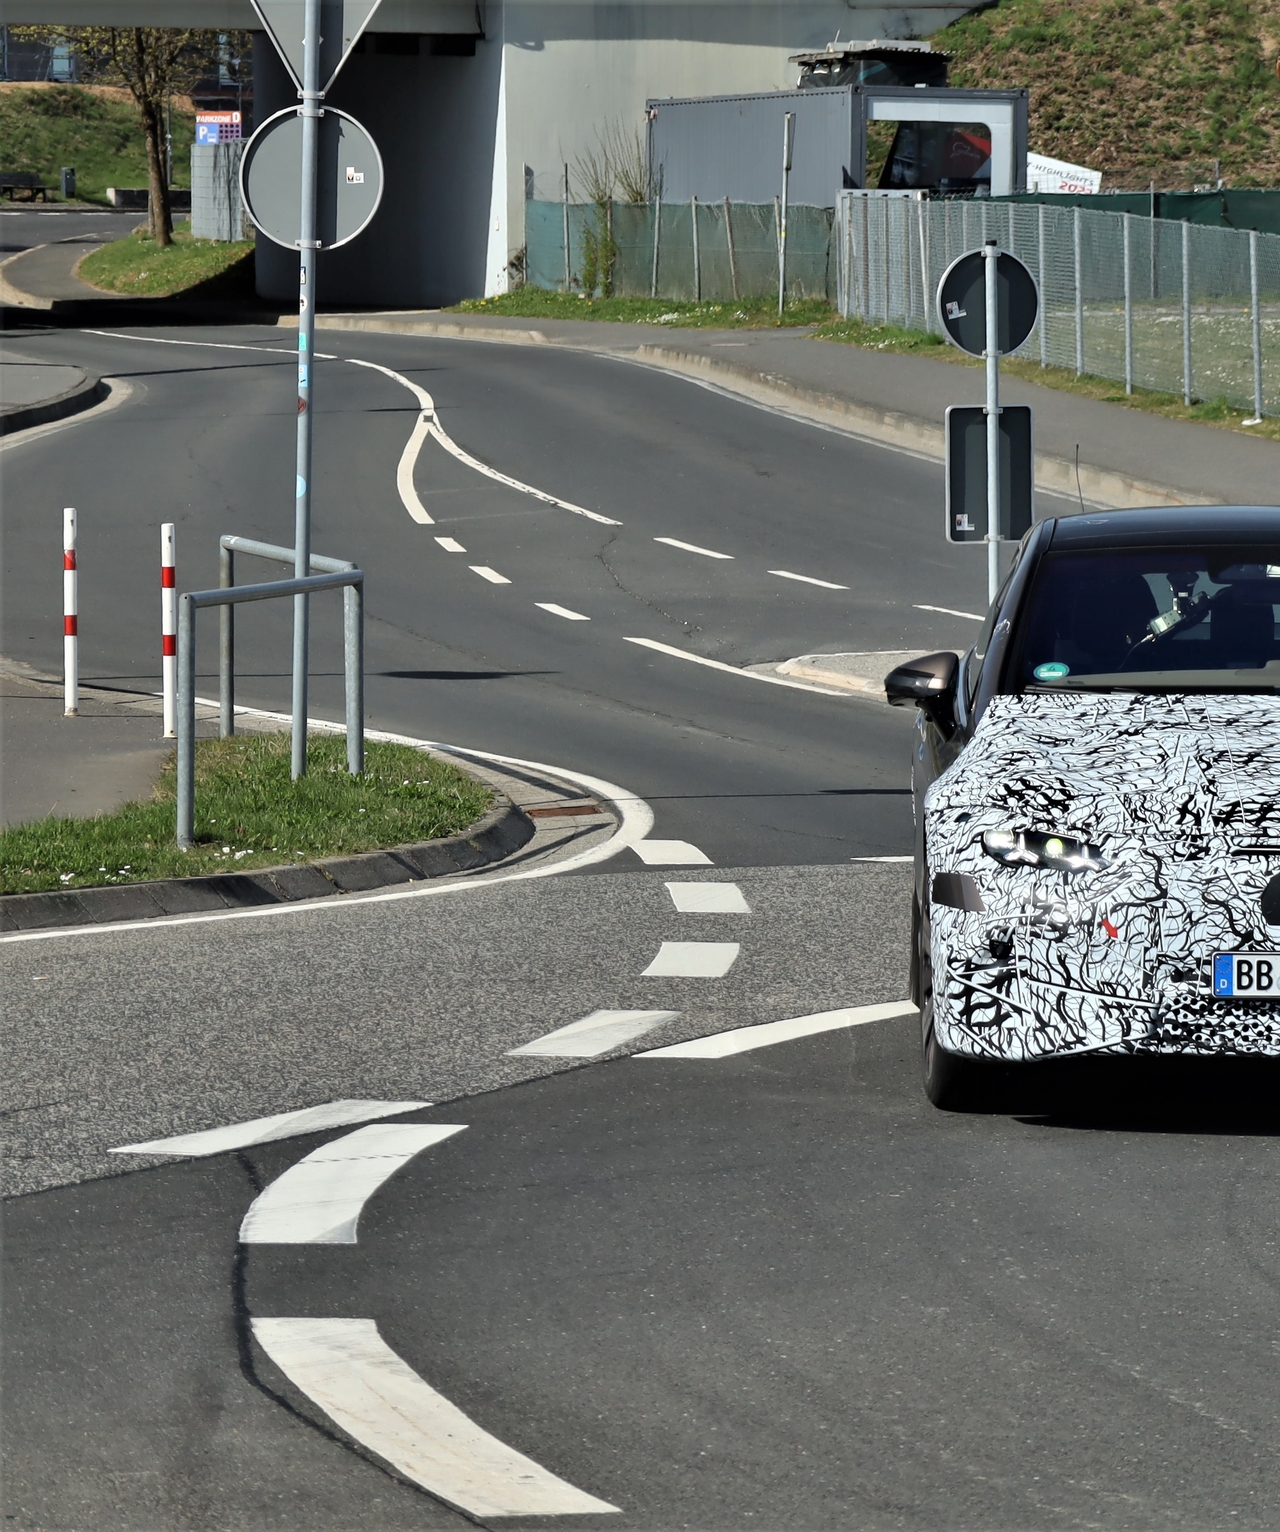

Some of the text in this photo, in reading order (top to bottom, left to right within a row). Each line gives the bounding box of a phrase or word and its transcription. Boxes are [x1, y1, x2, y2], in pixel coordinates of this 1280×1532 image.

[196, 111, 241, 123] PARKZONE D
[199, 126, 208, 140] P
[1236, 959, 1274, 991] BB
[1220, 979, 1228, 989] D
